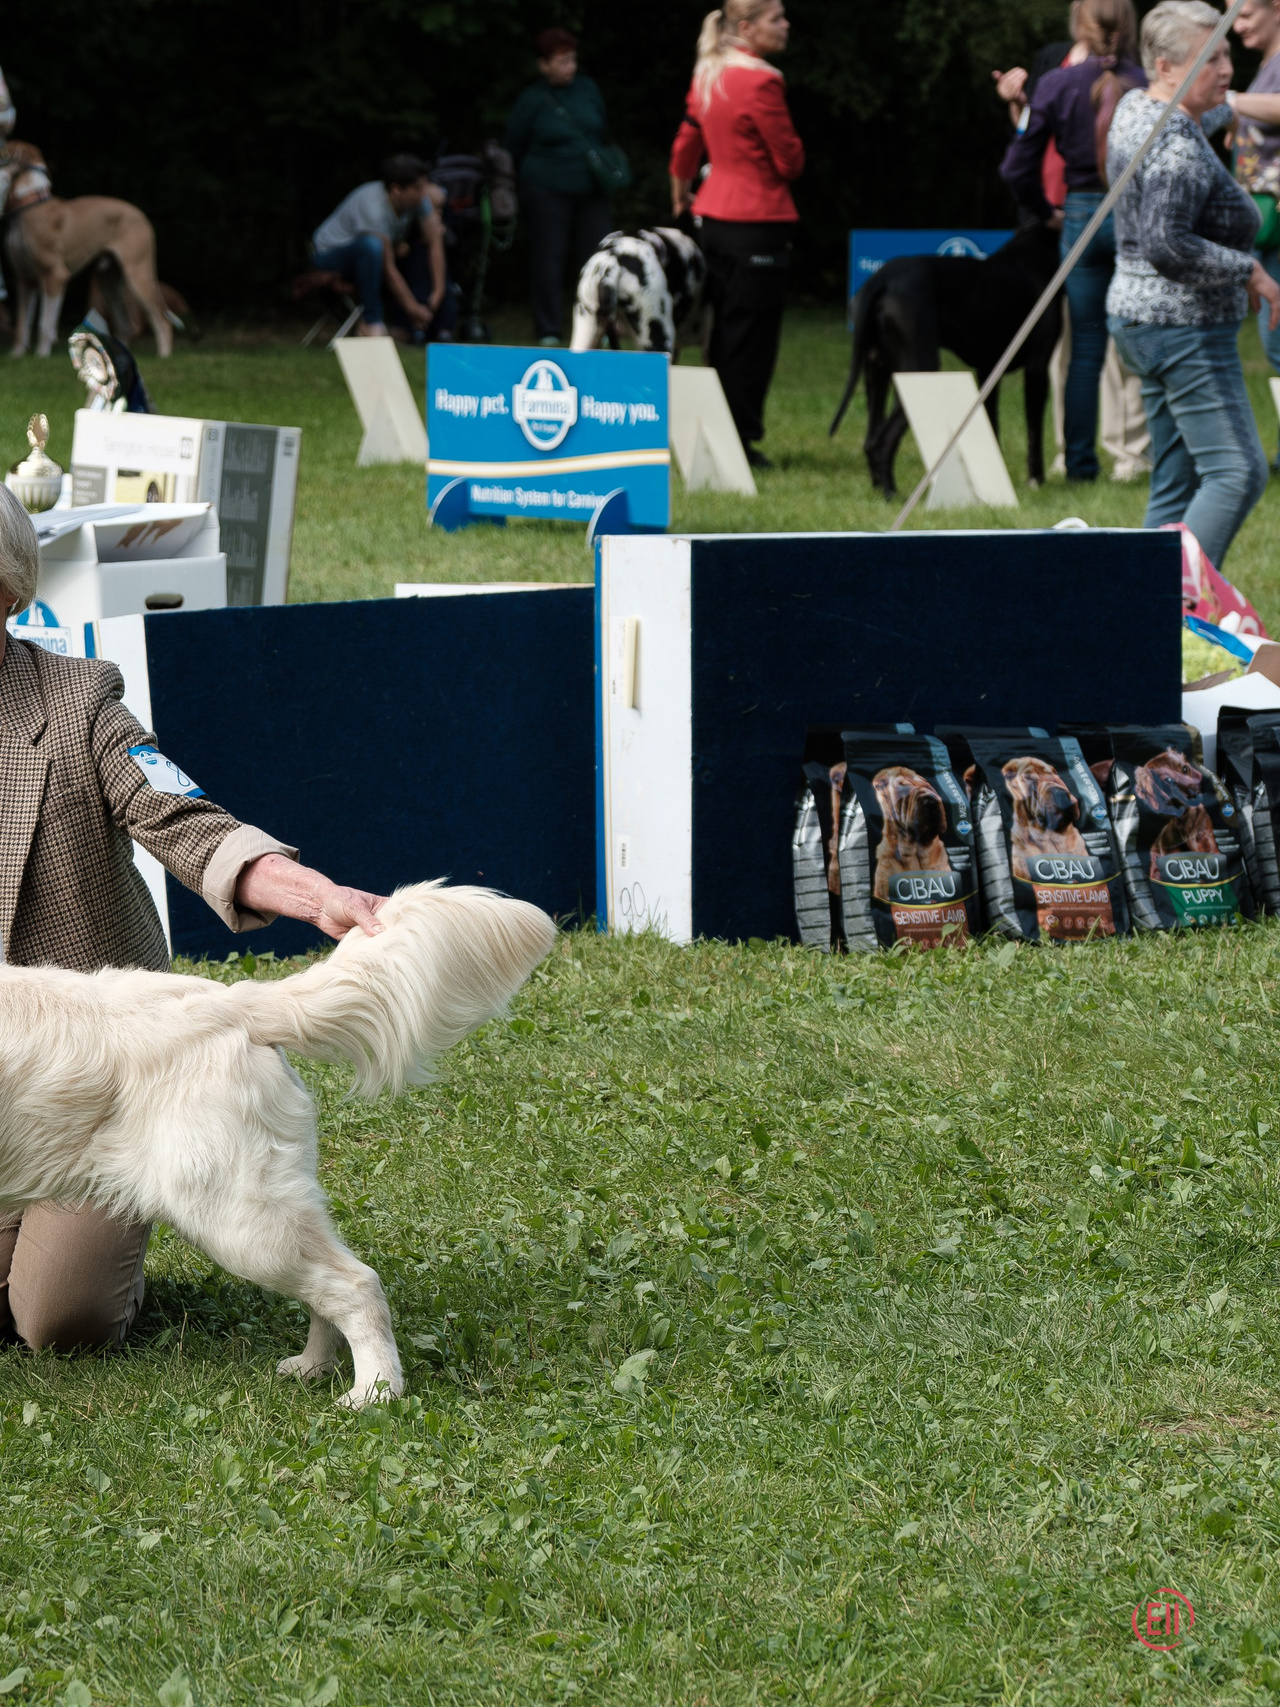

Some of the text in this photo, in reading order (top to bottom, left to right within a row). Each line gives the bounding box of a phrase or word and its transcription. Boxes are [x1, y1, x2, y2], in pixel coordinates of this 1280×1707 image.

[435, 388, 509, 418] Happy pet.
[521, 391, 571, 416] Farmina
[581, 395, 660, 426] Happy you.
[470, 484, 515, 505] Nutrition
[514, 486, 550, 509] System
[1035, 858, 1095, 880] CIBAU
[1165, 857, 1220, 880] CIBAU
[896, 875, 956, 901] CIBAU
[1036, 889, 1109, 904] SENSITIVE LAMB
[1181, 888, 1224, 904] PUPPY
[893, 908, 967, 926] SENSITIVE LAMB
